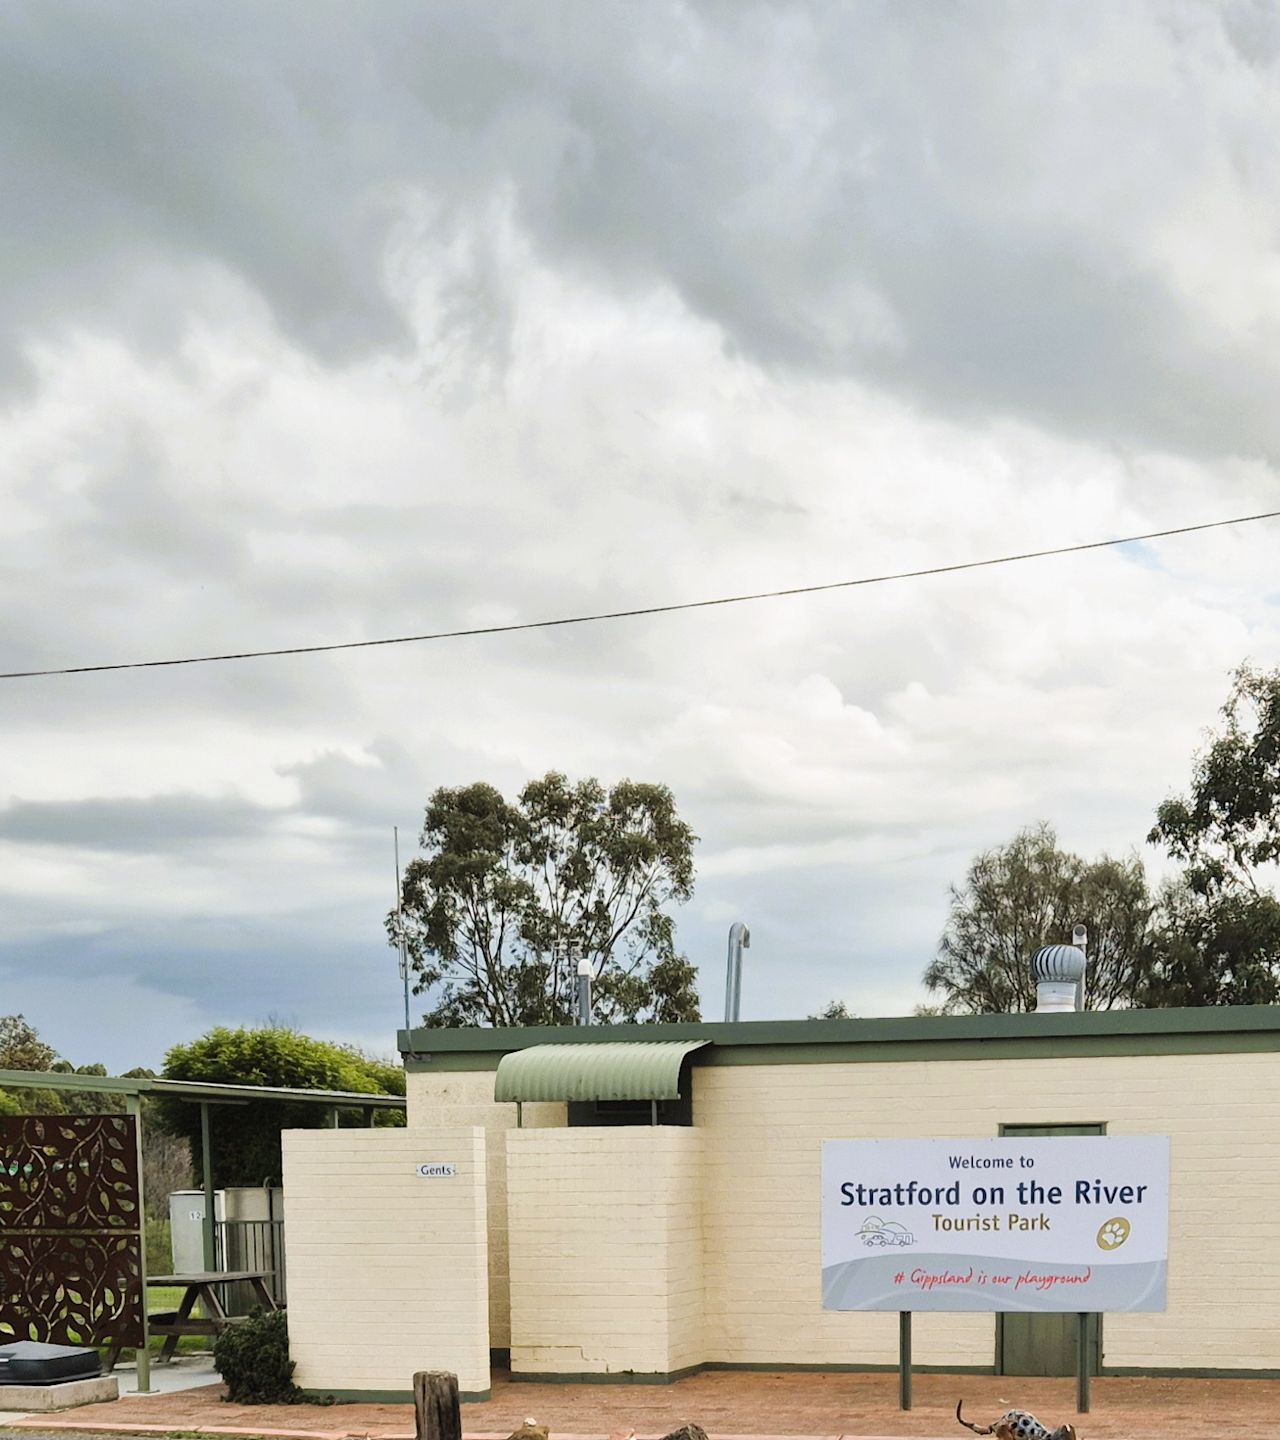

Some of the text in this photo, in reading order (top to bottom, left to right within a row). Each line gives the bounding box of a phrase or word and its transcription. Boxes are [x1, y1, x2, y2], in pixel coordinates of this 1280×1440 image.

[420, 1164, 452, 1176] Gents
[948, 1154, 1035, 1170] Welcome to
[840, 1178, 1148, 1206] Stratford on the River
[931, 1212, 1051, 1232] Tourist Park
[910, 1267, 973, 1289] Gippsland
[977, 1270, 987, 1285] is
[991, 1275, 1012, 1285] our
[1014, 1266, 1092, 1290] playground
